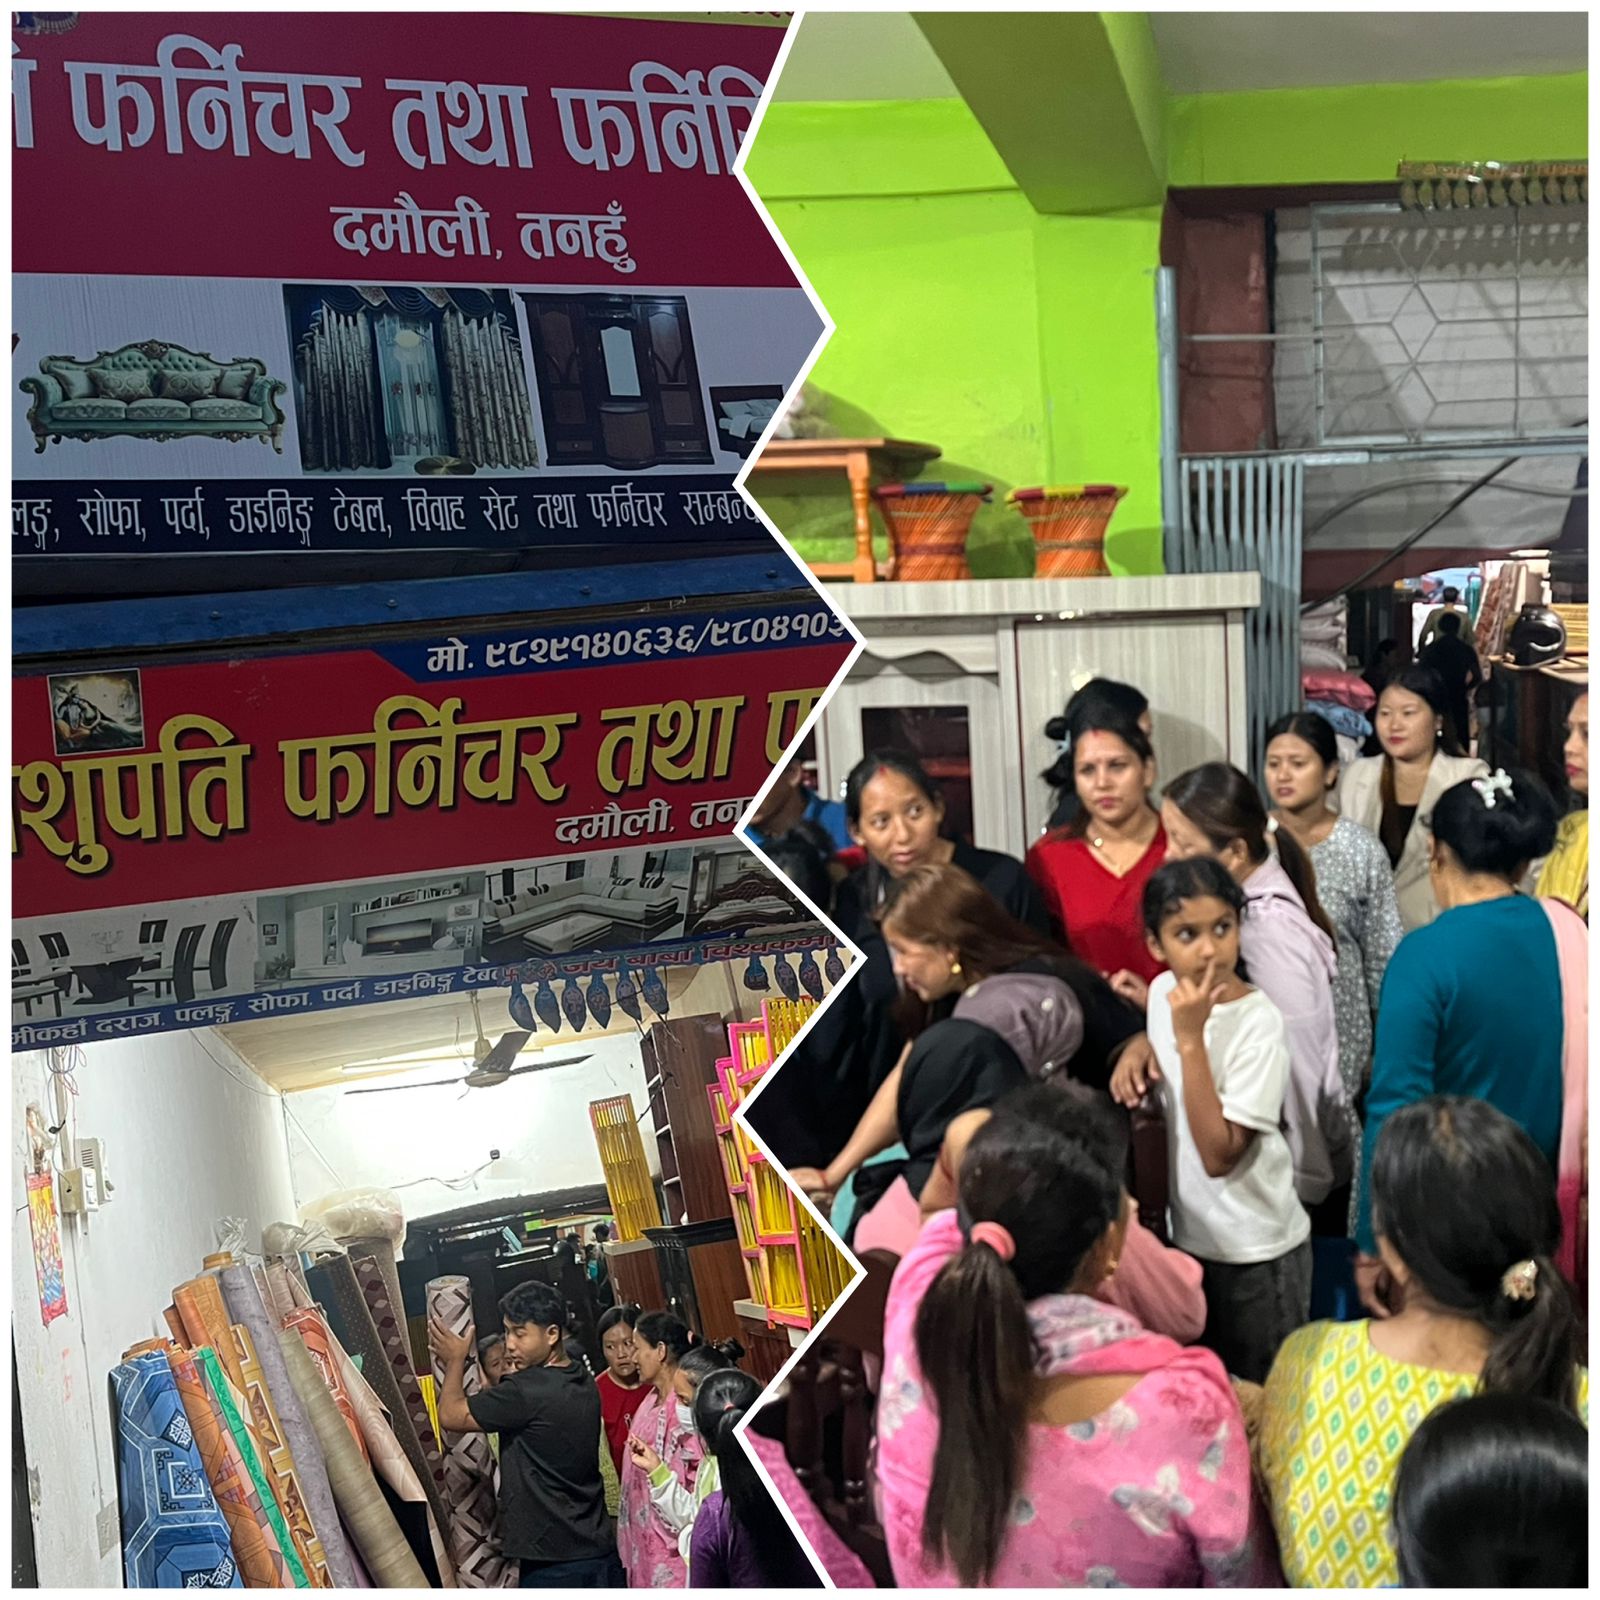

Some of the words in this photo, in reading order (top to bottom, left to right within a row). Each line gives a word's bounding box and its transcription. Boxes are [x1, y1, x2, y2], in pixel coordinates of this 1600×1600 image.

[63, 34, 365, 168] फर्निचर
[385, 78, 533, 169] तथा
[329, 191, 502, 260] दमौली,
[516, 200, 637, 273] तनहुँ
[77, 489, 146, 542] सोफा,
[160, 486, 210, 540] पर्दा,
[330, 487, 392, 539] टेबल,
[401, 487, 466, 531] विवाह
[480, 486, 519, 531] सेट
[533, 494, 578, 529] तथा
[587, 482, 667, 527] फर्निचर
[427, 637, 474, 672] मो.
[12, 714, 251, 874] शुपति
[278, 694, 577, 821] फर्निचर
[597, 695, 745, 793] तथा
[555, 798, 675, 844] दमौली,
[690, 796, 755, 829] तन
